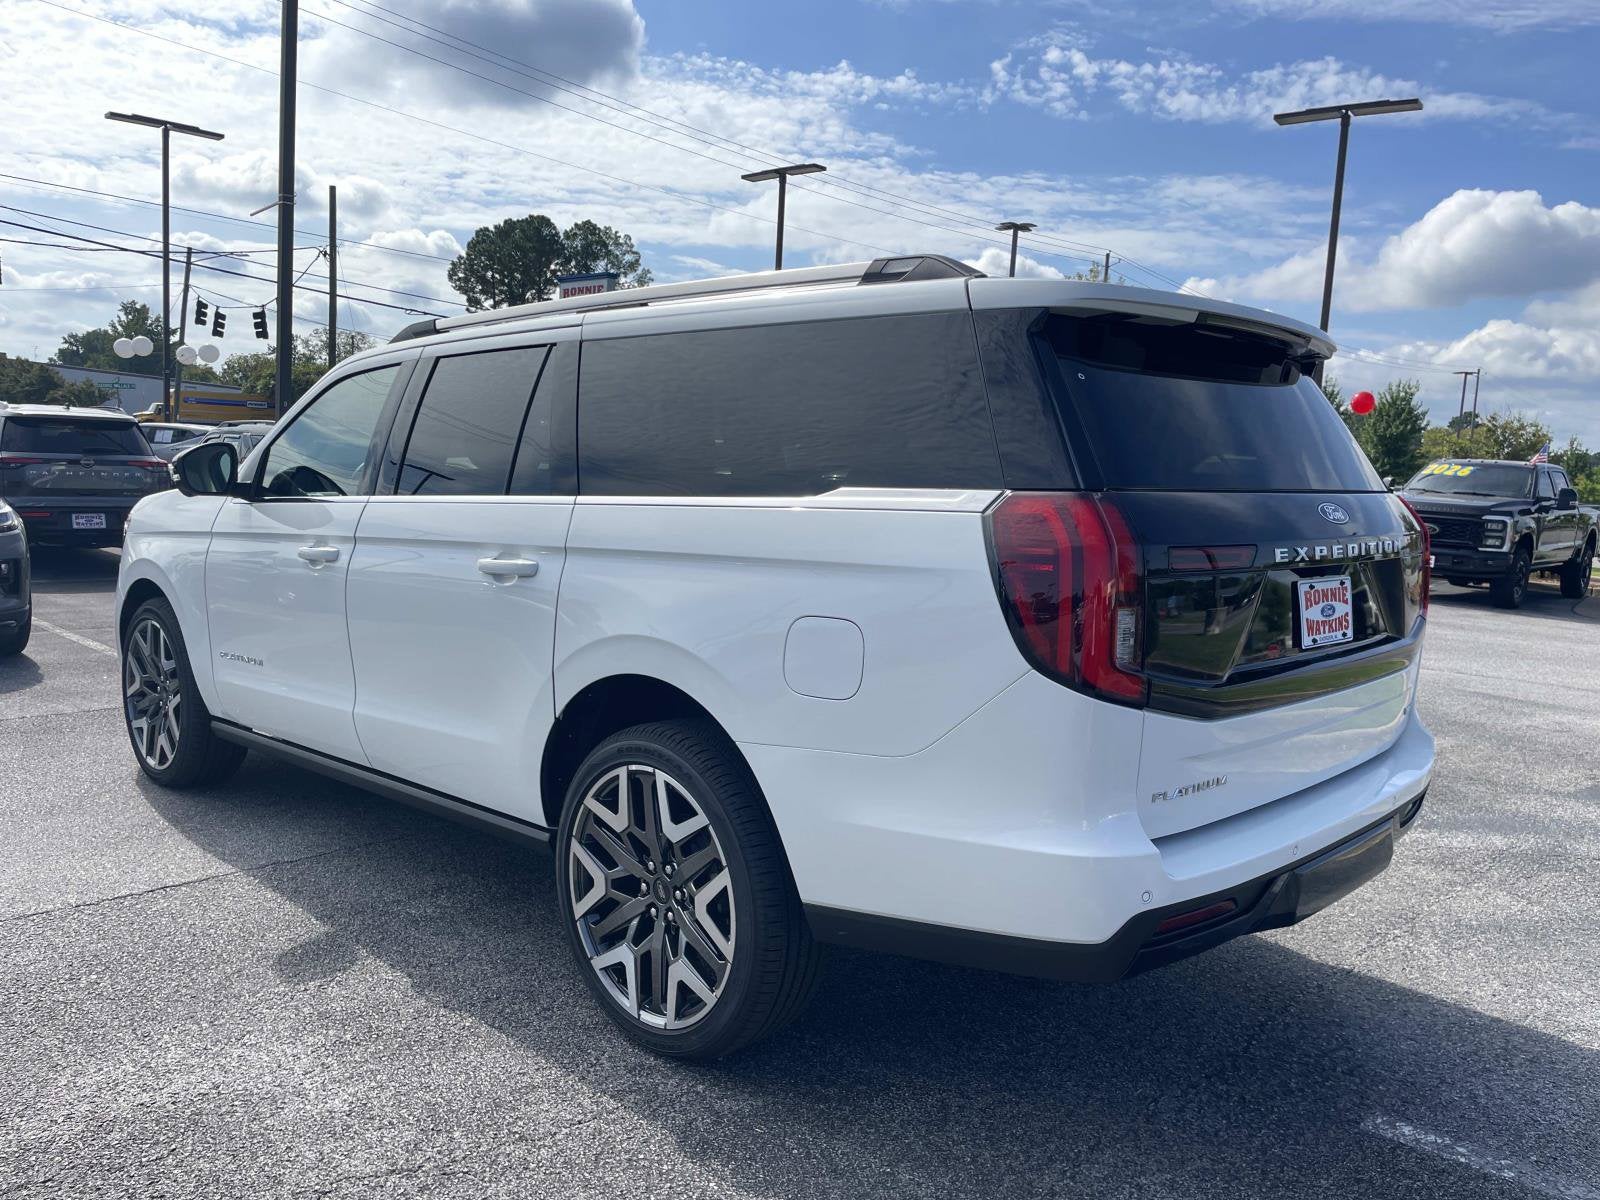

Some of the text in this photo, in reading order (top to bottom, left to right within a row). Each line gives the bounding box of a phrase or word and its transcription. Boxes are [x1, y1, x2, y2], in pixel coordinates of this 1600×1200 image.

[563, 284, 604, 298] RONNIE
[1322, 504, 1346, 521] Ford
[1274, 540, 1401, 563] EXPEDITION
[1304, 586, 1349, 611] RONNIE
[1306, 612, 1350, 637] WATKINS
[219, 651, 264, 667] PLATINUM
[1151, 775, 1228, 804] PLATINUM
